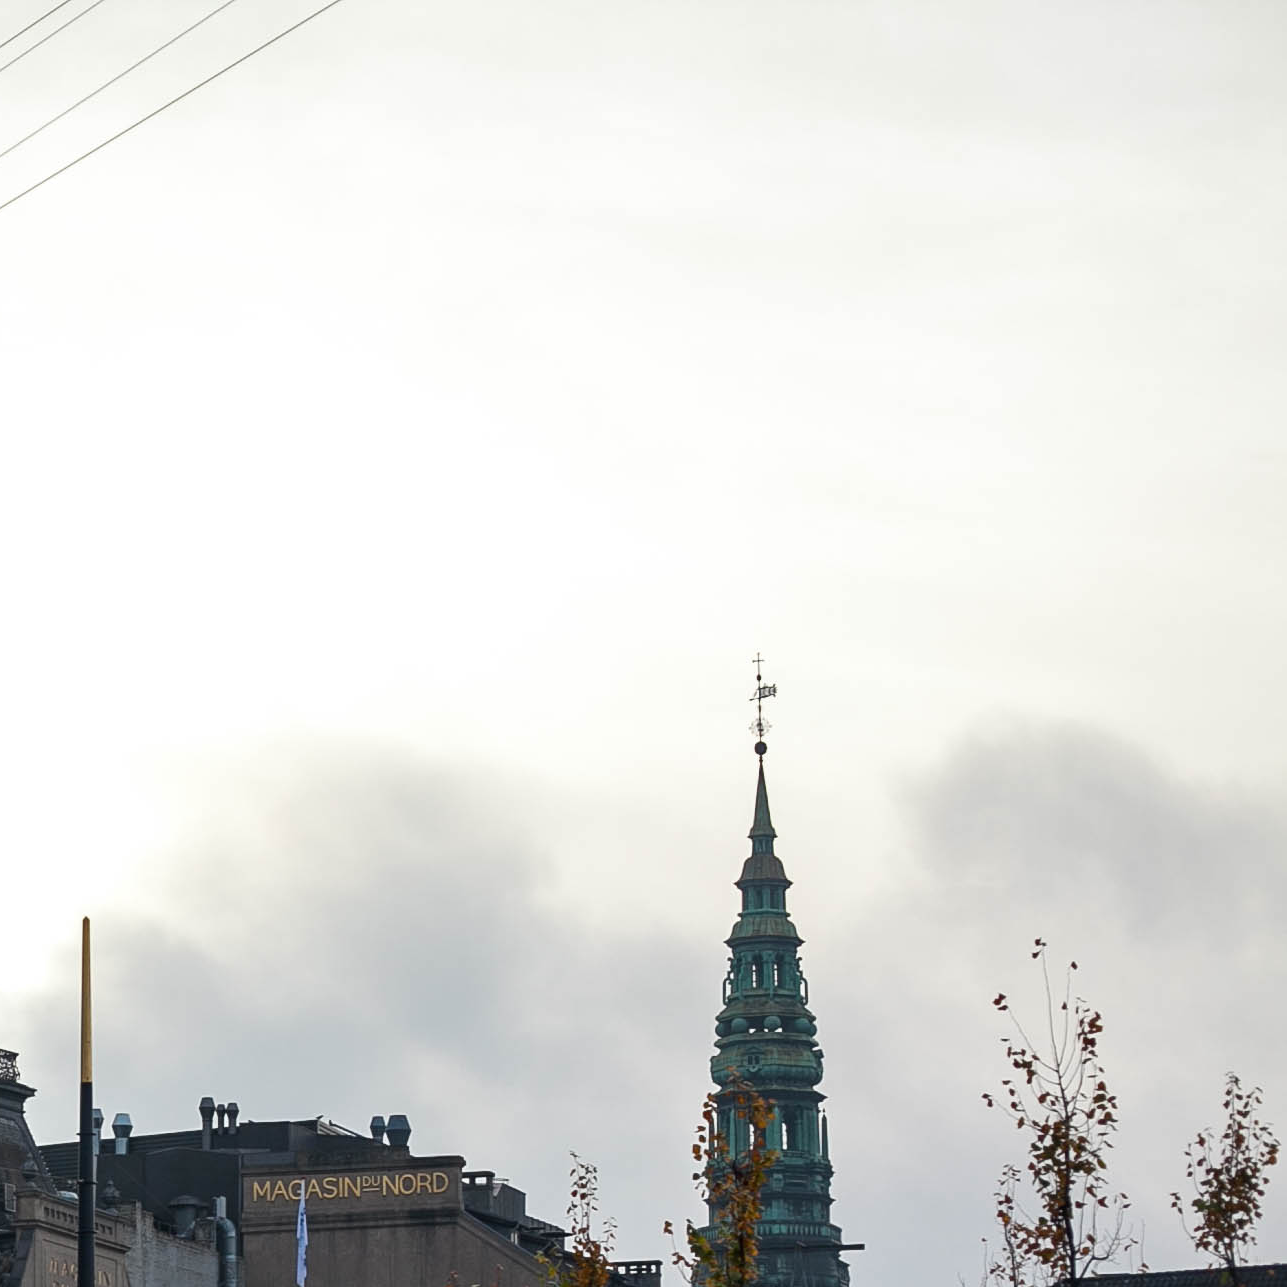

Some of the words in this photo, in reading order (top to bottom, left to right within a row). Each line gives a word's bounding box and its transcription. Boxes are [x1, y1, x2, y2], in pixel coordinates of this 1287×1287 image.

[253, 1176, 361, 1202] MAGASIN
[362, 1175, 380, 1187] DU
[382, 1172, 449, 1197] NORD
